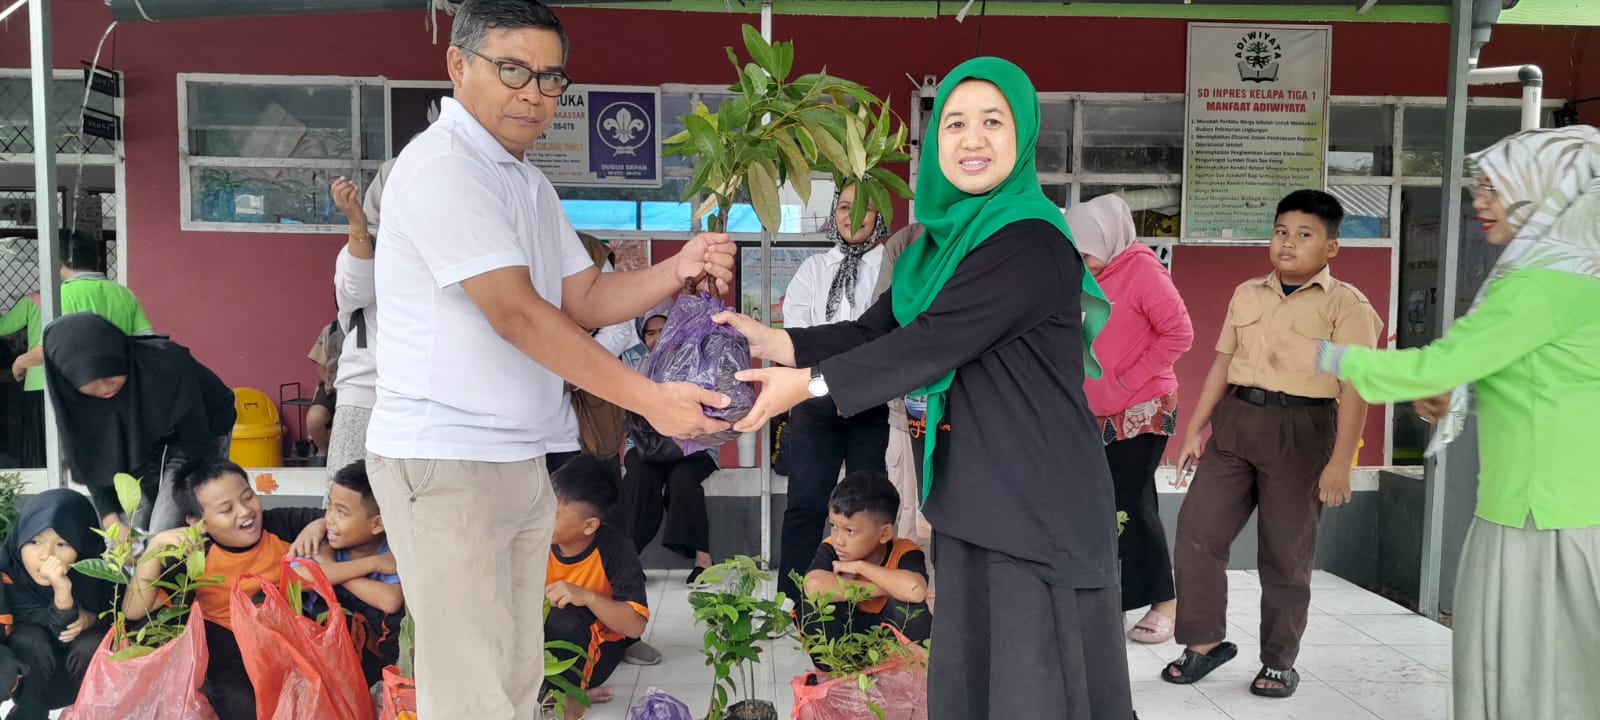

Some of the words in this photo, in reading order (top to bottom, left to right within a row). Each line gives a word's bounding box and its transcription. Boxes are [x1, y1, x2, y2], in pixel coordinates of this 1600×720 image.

[1234, 31, 1282, 60] ADIWIYATA
[1197, 88, 1210, 99] SD
[1213, 88, 1247, 99] INPRES
[1249, 90, 1284, 100] KELAPA
[1287, 91, 1308, 101] TIGA
[1311, 92, 1317, 101] 1
[1206, 101, 1251, 112] MANFAAT
[1253, 103, 1307, 113] ADIWIYATA
[553, 111, 585, 119] AKASSAR
